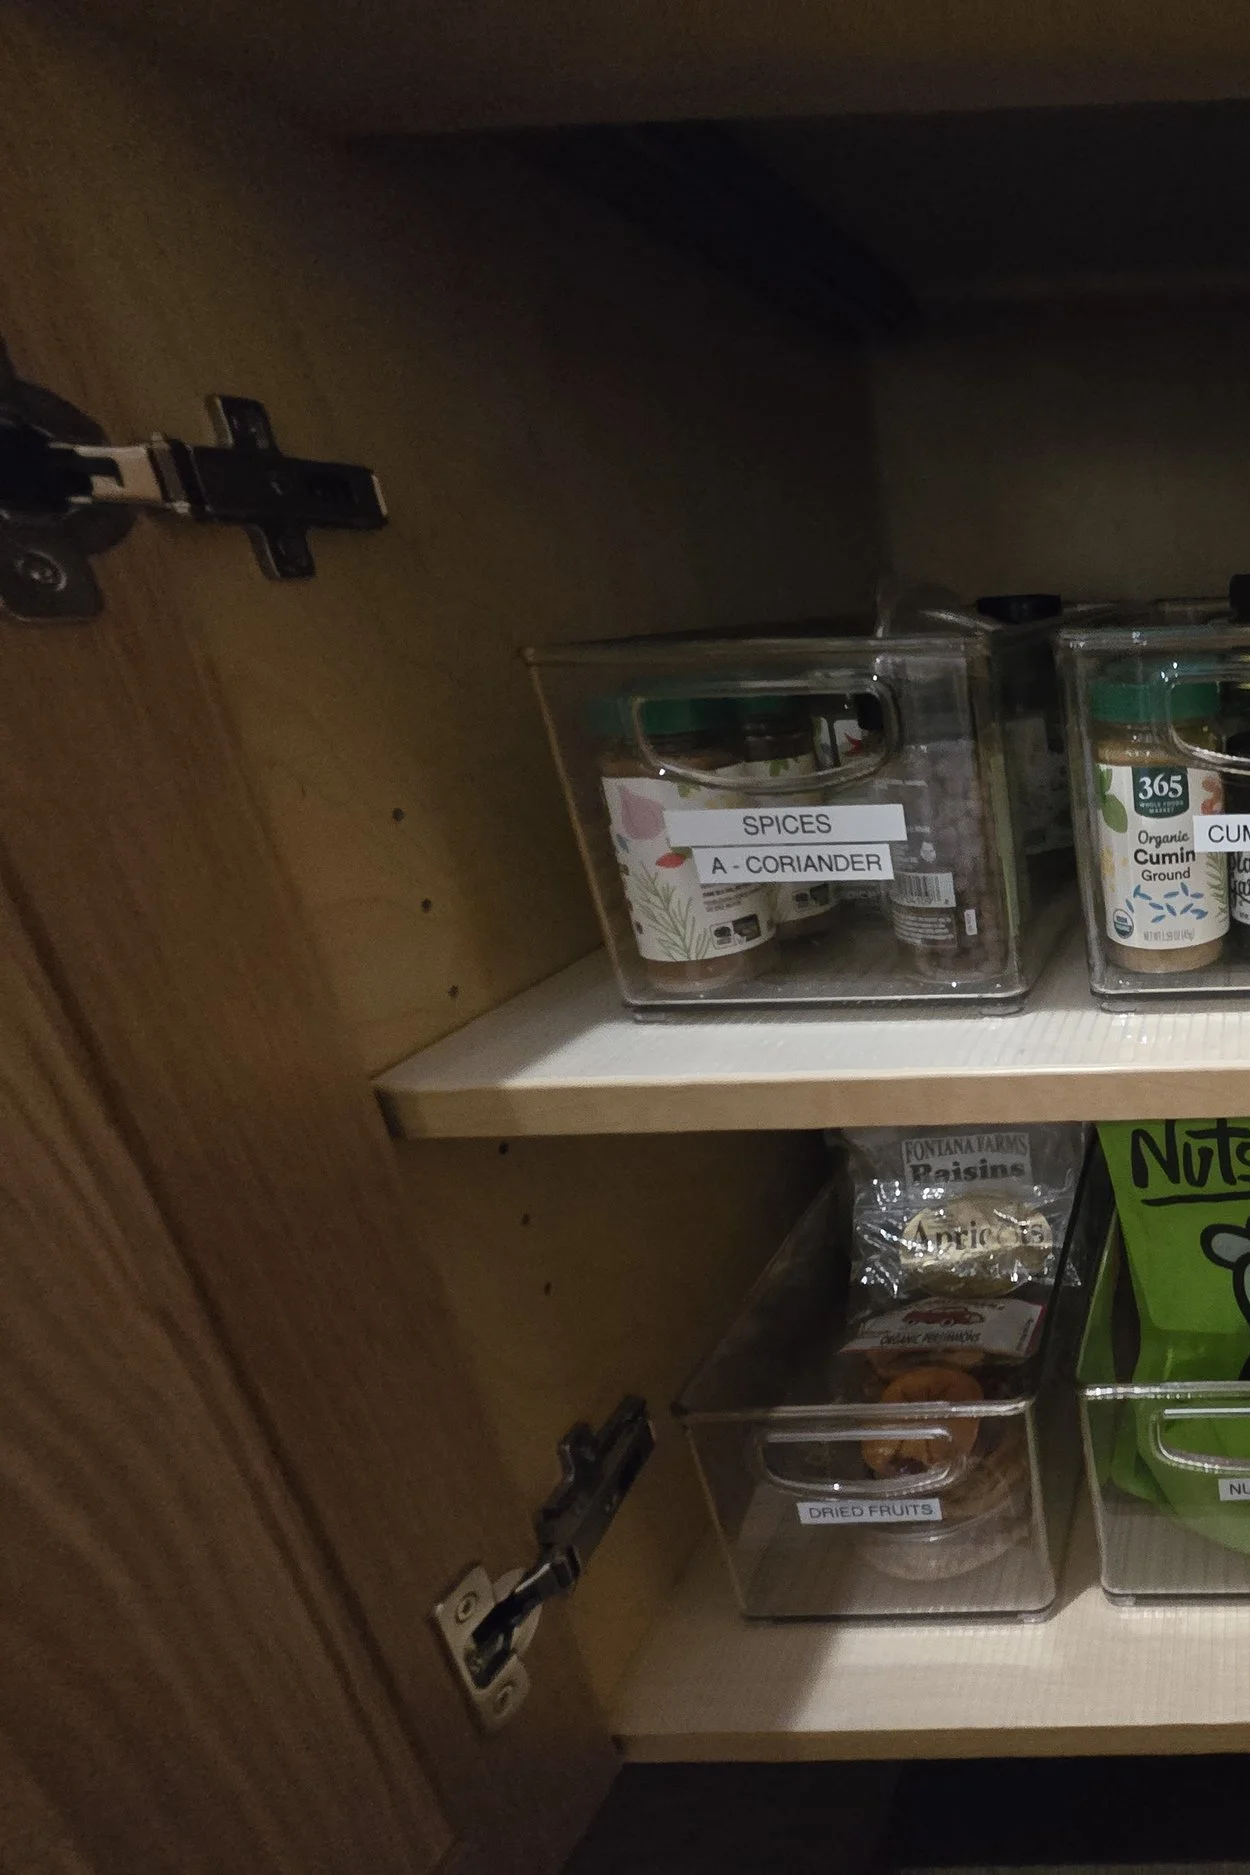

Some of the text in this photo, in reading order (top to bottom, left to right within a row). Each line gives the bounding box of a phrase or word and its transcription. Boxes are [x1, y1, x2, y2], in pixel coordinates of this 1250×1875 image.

[1138, 772, 1184, 800] 365
[743, 813, 832, 836] SPICES
[1137, 829, 1191, 848] Organic
[711, 856, 728, 875] A
[745, 854, 883, 874] CORIANDER
[1133, 847, 1197, 866] Cumin
[1141, 867, 1191, 882] Ground
[904, 1133, 1028, 1163] FONTANA FARMS
[909, 1158, 1026, 1184] Raisins
[808, 1503, 934, 1519] DRIED FRUITS
